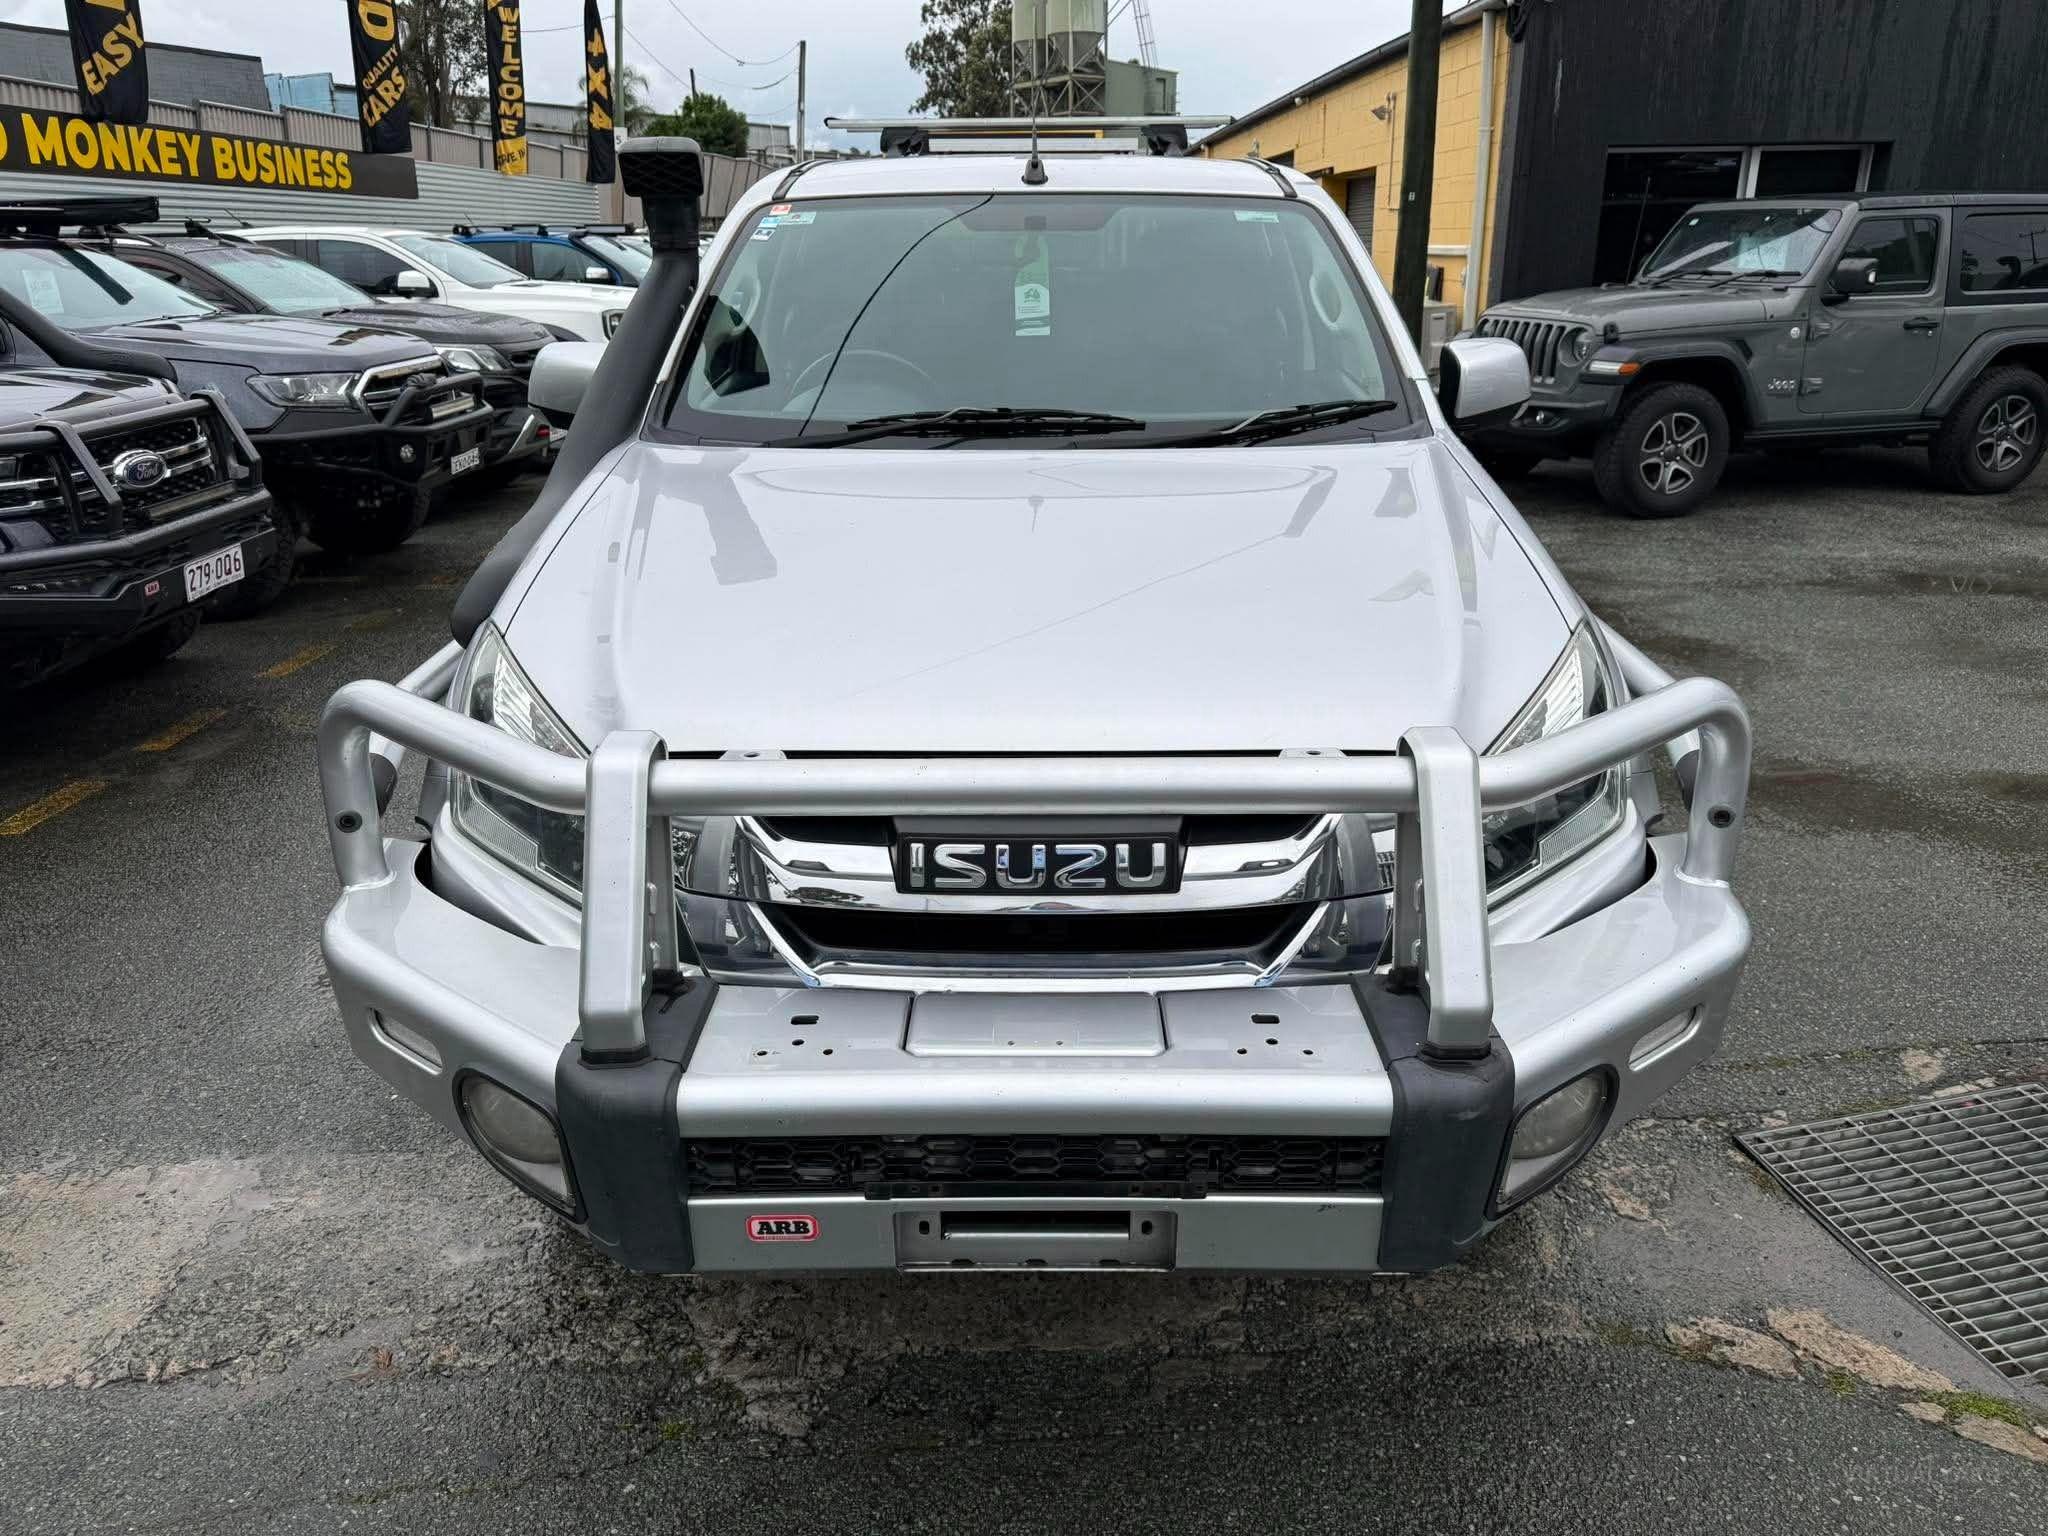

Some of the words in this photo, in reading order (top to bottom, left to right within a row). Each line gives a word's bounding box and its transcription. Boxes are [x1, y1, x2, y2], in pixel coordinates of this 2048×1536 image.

[81, 12, 144, 96] EASY
[362, 43, 398, 89] QUALITY
[498, 6, 526, 136] WELCOME
[363, 65, 405, 127] CARS
[21, 113, 200, 177] MONKEY
[211, 137, 352, 189] BUSINESS
[136, 461, 158, 480] Ford
[910, 843, 1167, 889] ISUZU
[757, 1221, 810, 1235] ARB
